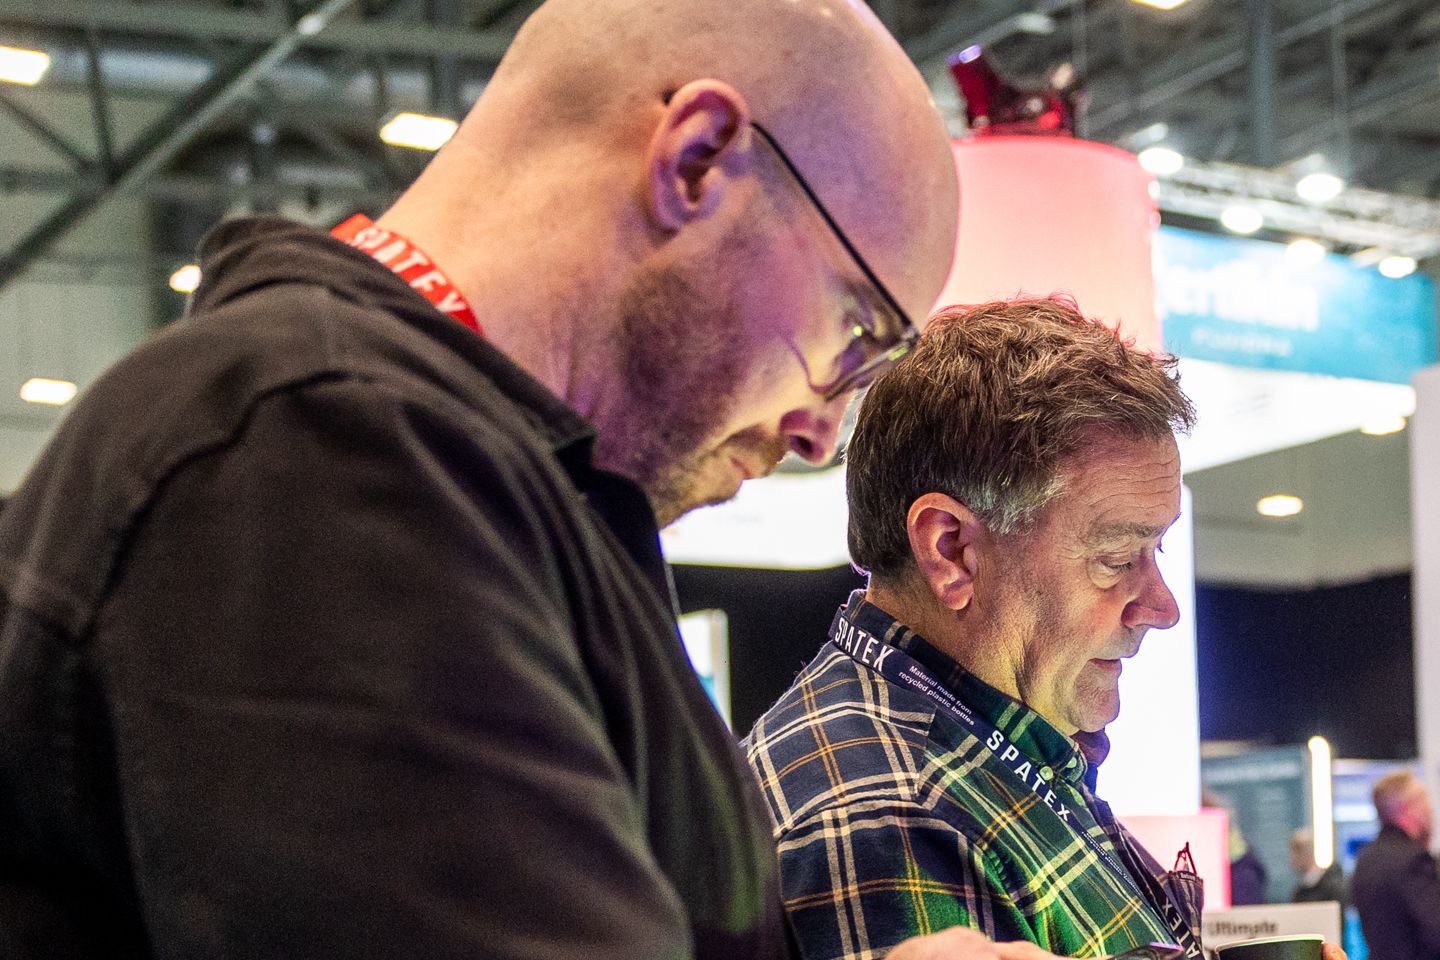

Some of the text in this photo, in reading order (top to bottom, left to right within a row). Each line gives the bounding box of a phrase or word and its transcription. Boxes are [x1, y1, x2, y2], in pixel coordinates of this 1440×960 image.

[834, 617, 894, 672] SPATEX
[898, 671, 975, 726] recycled plastic bottles
[909, 665, 973, 715] Material made from
[986, 730, 1070, 822] SPATEX
